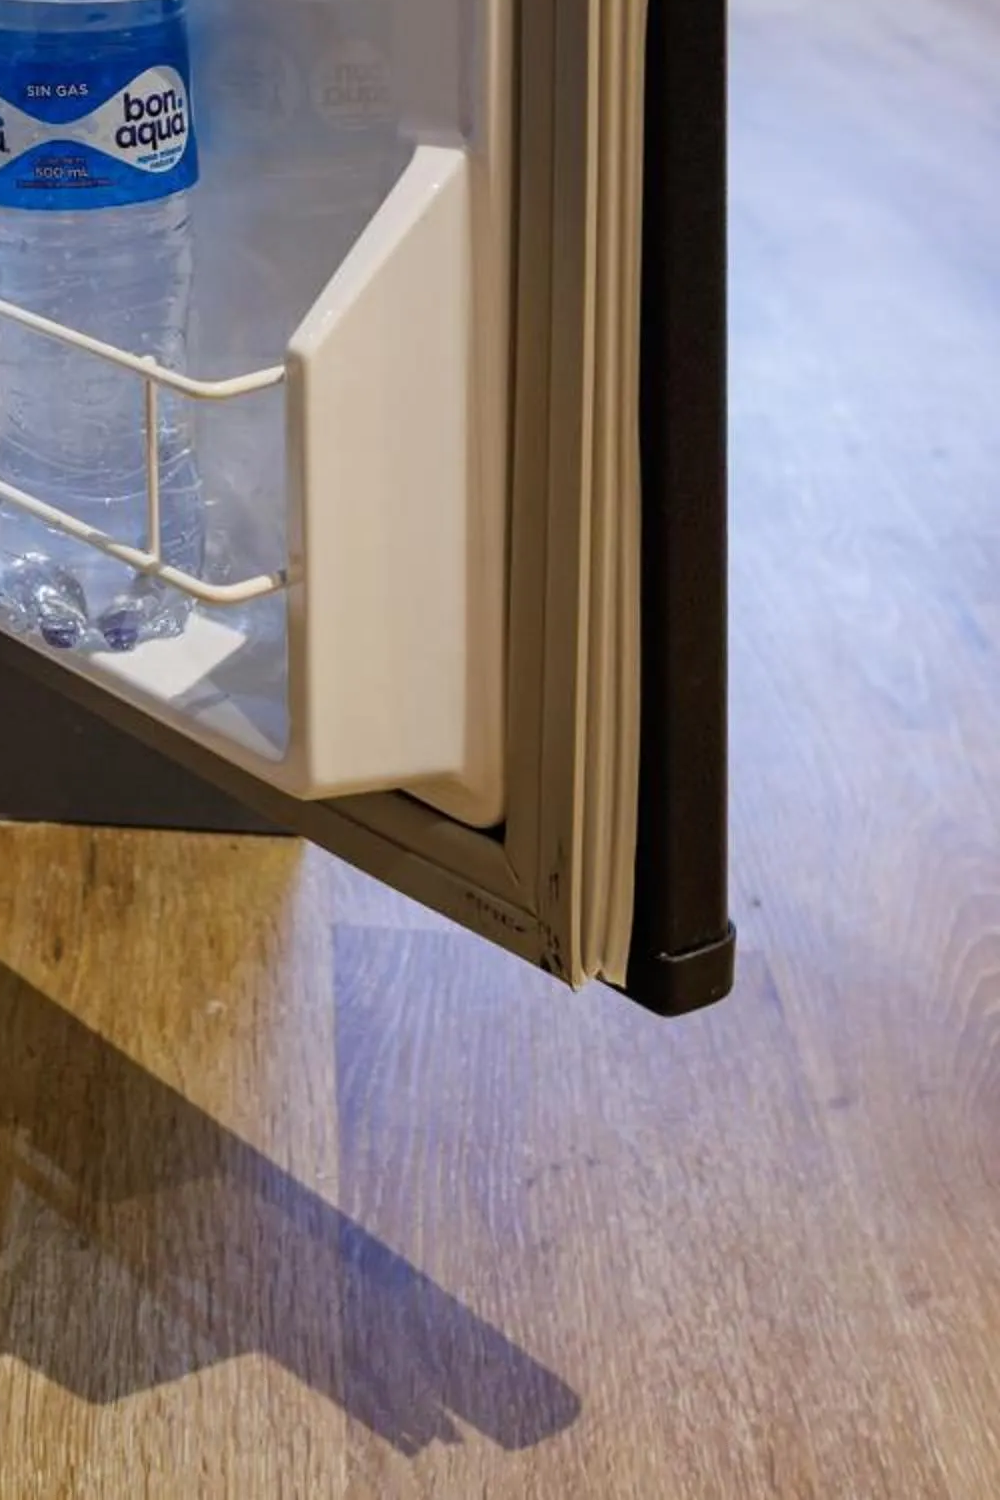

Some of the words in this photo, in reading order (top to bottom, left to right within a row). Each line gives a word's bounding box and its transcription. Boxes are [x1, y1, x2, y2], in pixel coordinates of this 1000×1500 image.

[26, 84, 51, 97] SIN
[55, 83, 88, 97] GAS
[115, 111, 185, 150] aqua
[34, 166, 64, 178] 500
